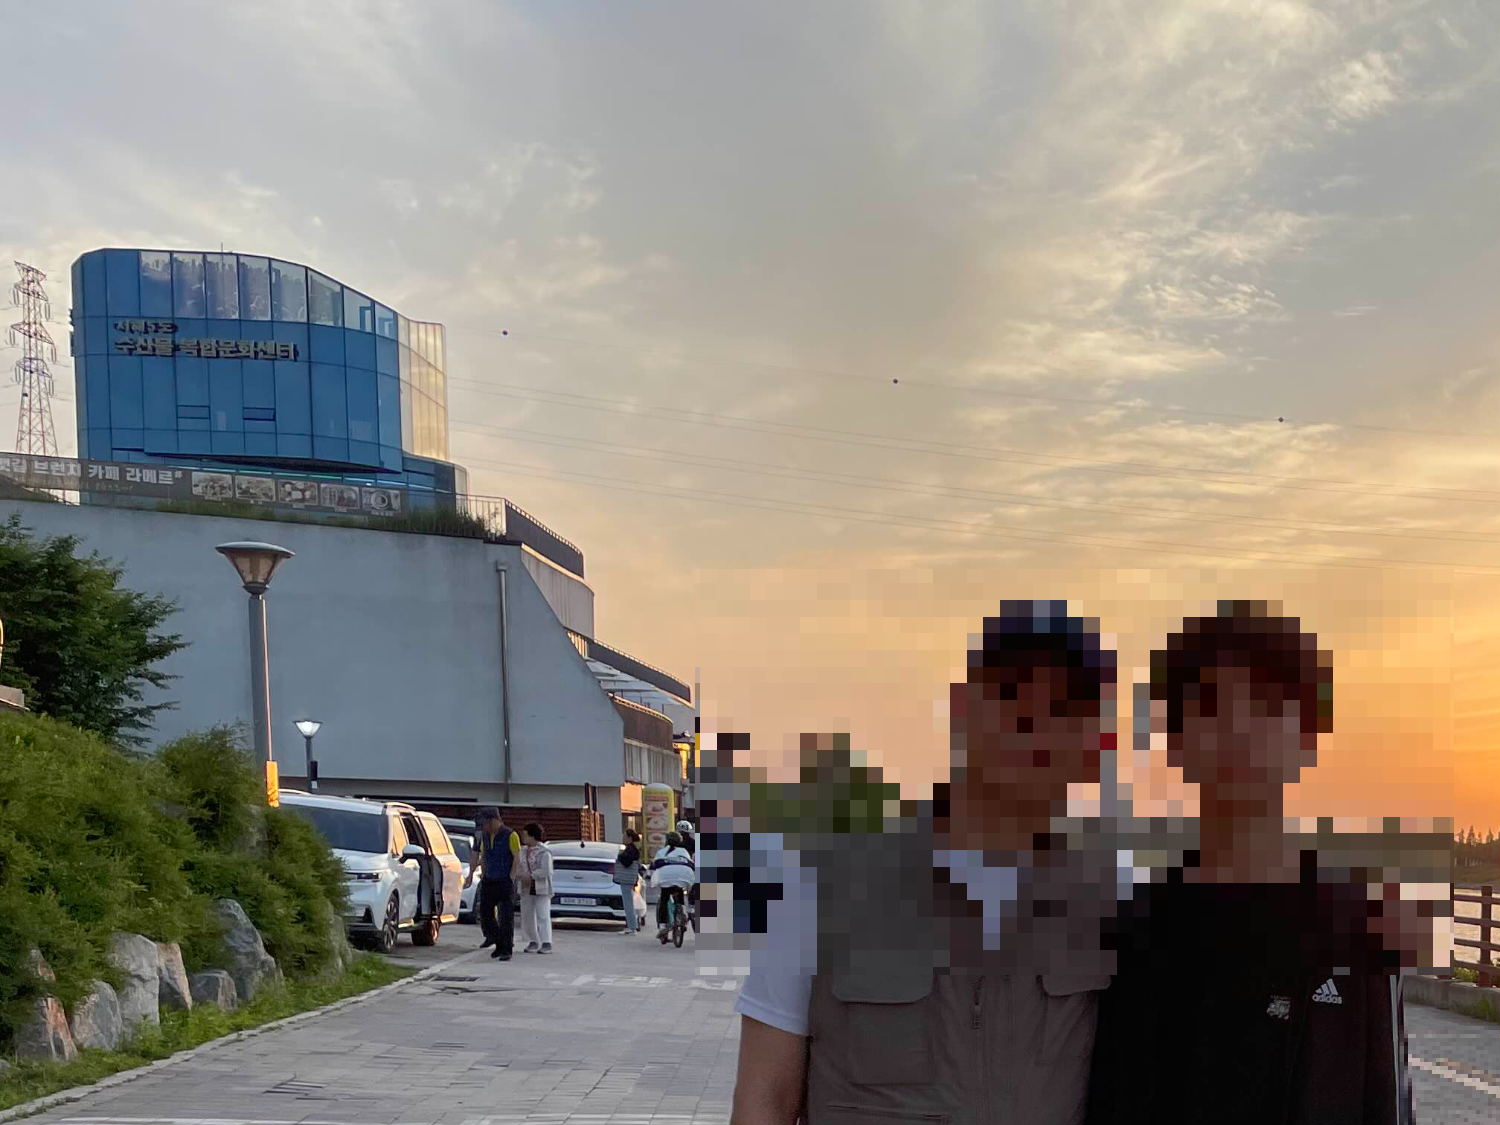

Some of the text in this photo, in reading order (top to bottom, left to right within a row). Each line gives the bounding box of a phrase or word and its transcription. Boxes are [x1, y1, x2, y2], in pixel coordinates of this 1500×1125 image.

[114, 337, 174, 357] 수산물
[88, 464, 120, 481] 카페
[1312, 993, 1343, 1005] adidas
